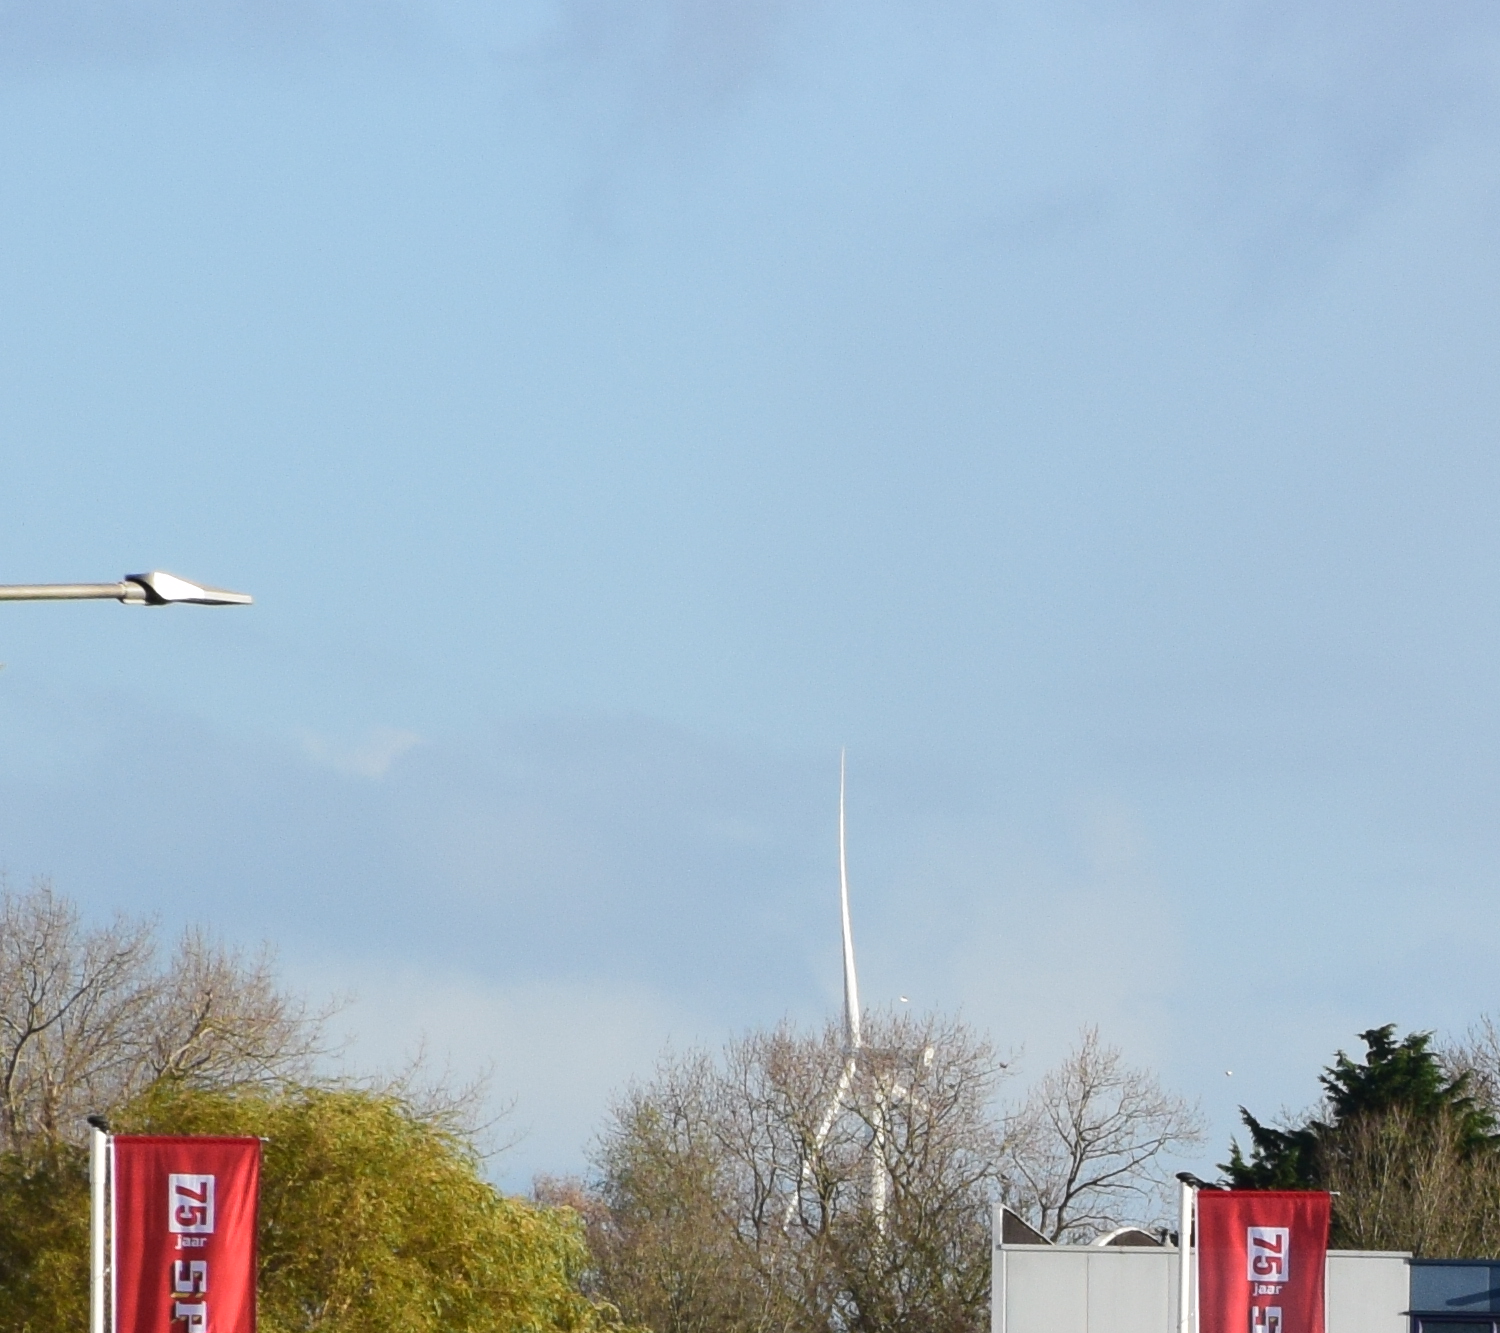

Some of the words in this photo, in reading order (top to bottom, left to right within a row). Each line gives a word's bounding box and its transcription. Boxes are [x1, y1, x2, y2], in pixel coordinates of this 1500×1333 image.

[173, 1180, 209, 1229] 75
[174, 1233, 208, 1250] jaar
[1251, 1234, 1284, 1277] 75
[1253, 1283, 1283, 1297] jaar
